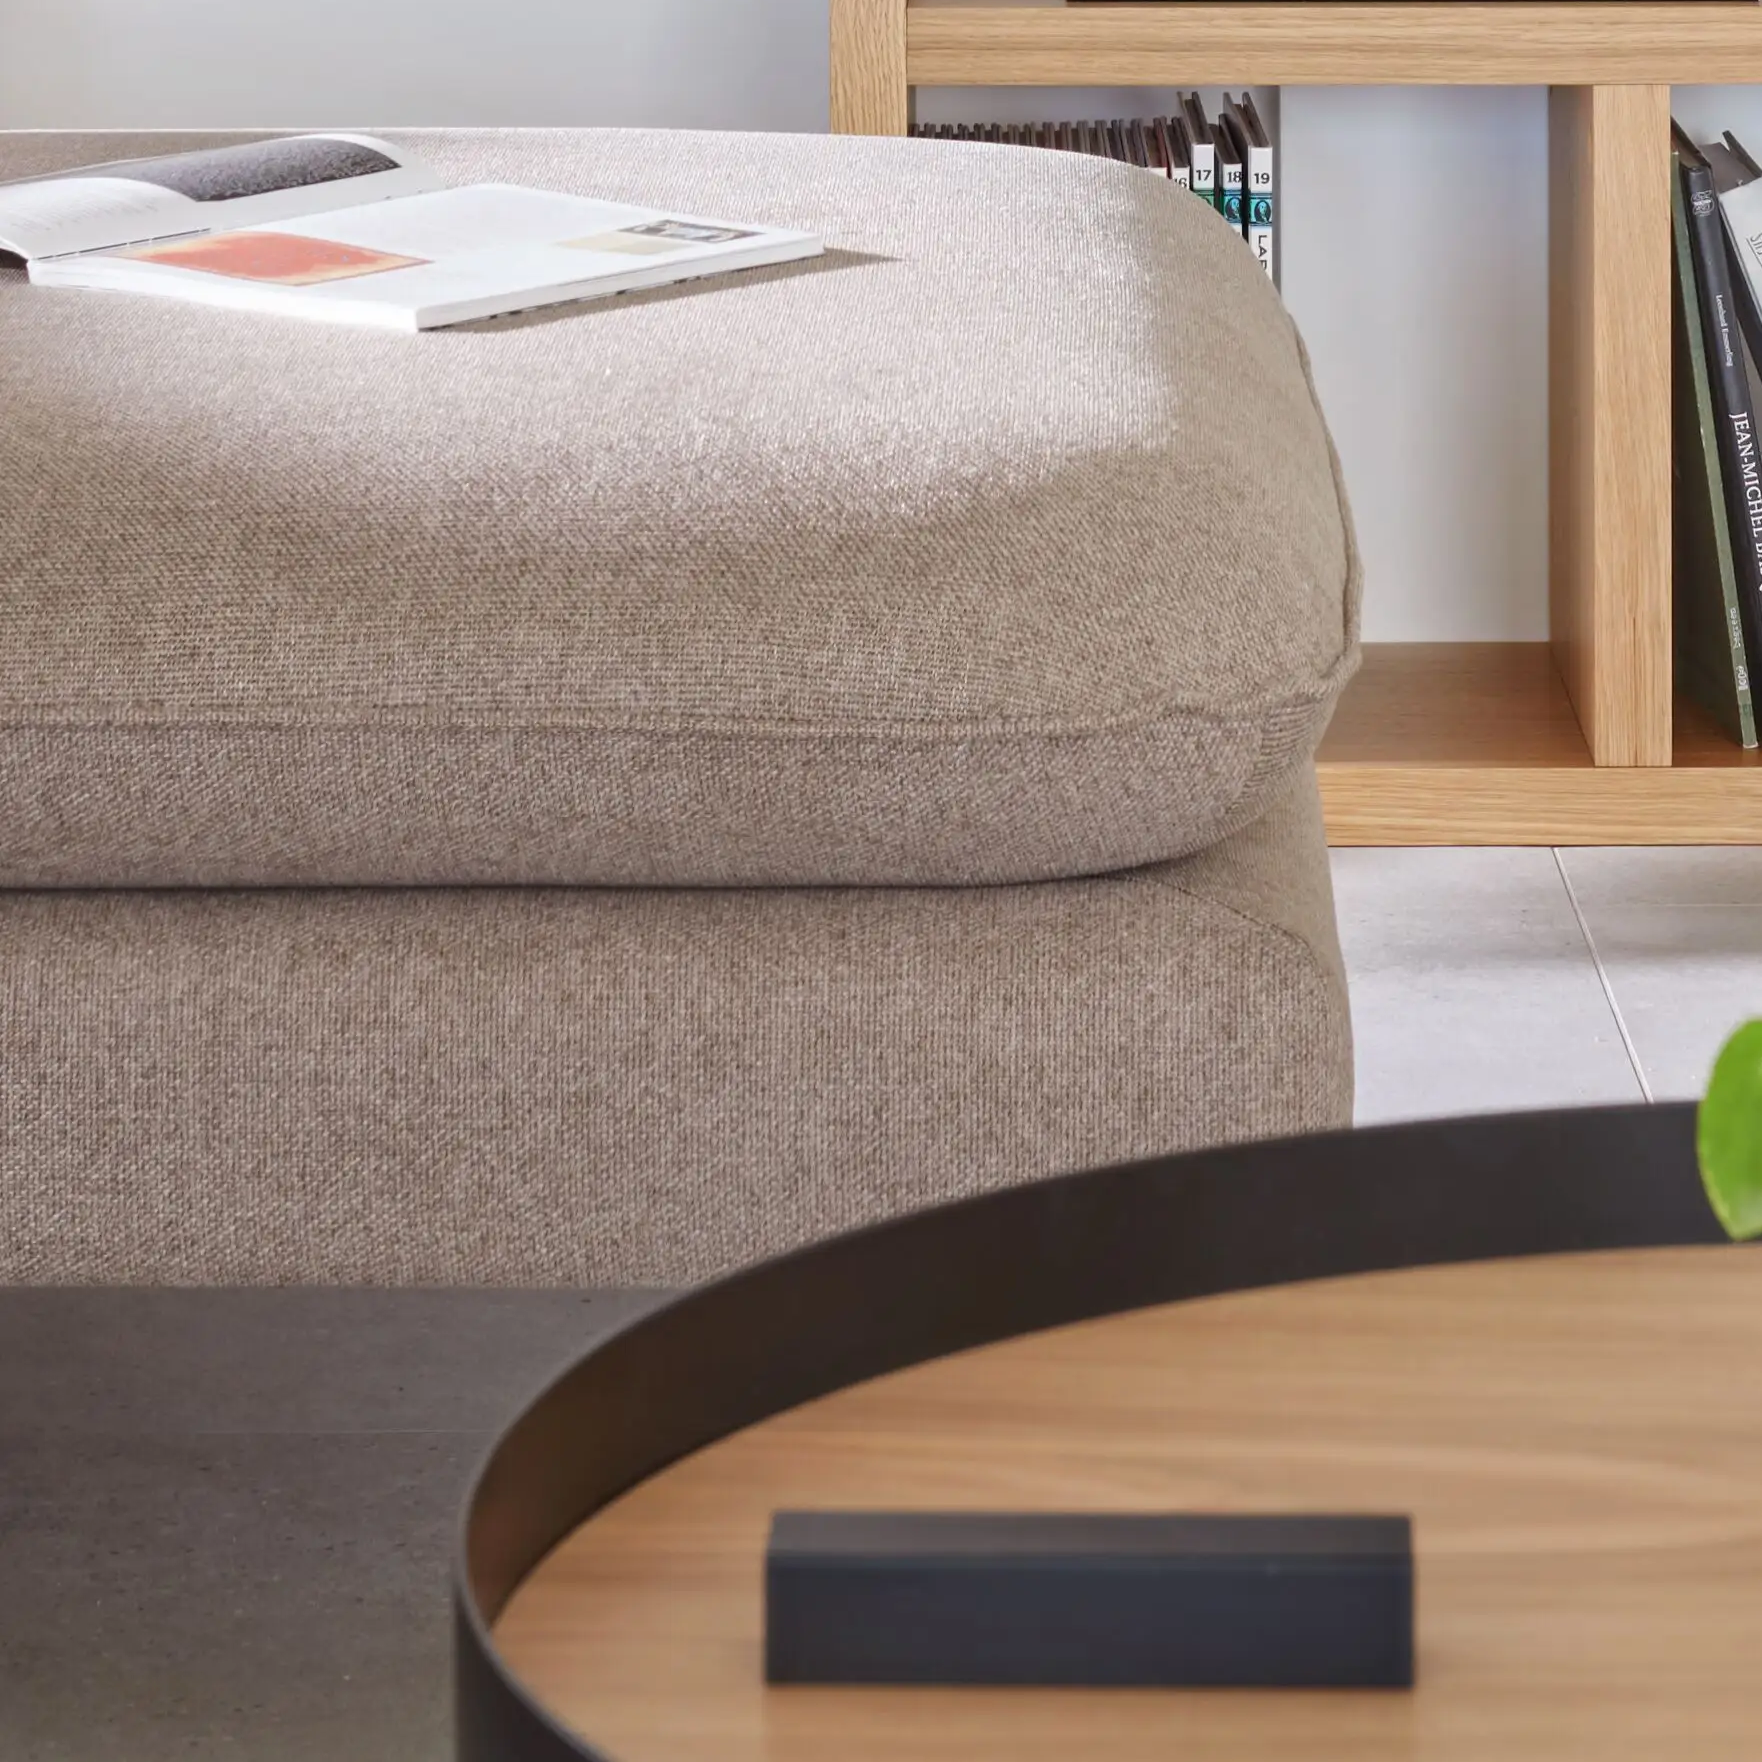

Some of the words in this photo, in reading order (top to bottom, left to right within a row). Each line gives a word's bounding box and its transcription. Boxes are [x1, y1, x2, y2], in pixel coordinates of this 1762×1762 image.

[1195, 169, 1212, 181] 17
[1227, 170, 1243, 183] 18
[1253, 172, 1270, 184] 19
